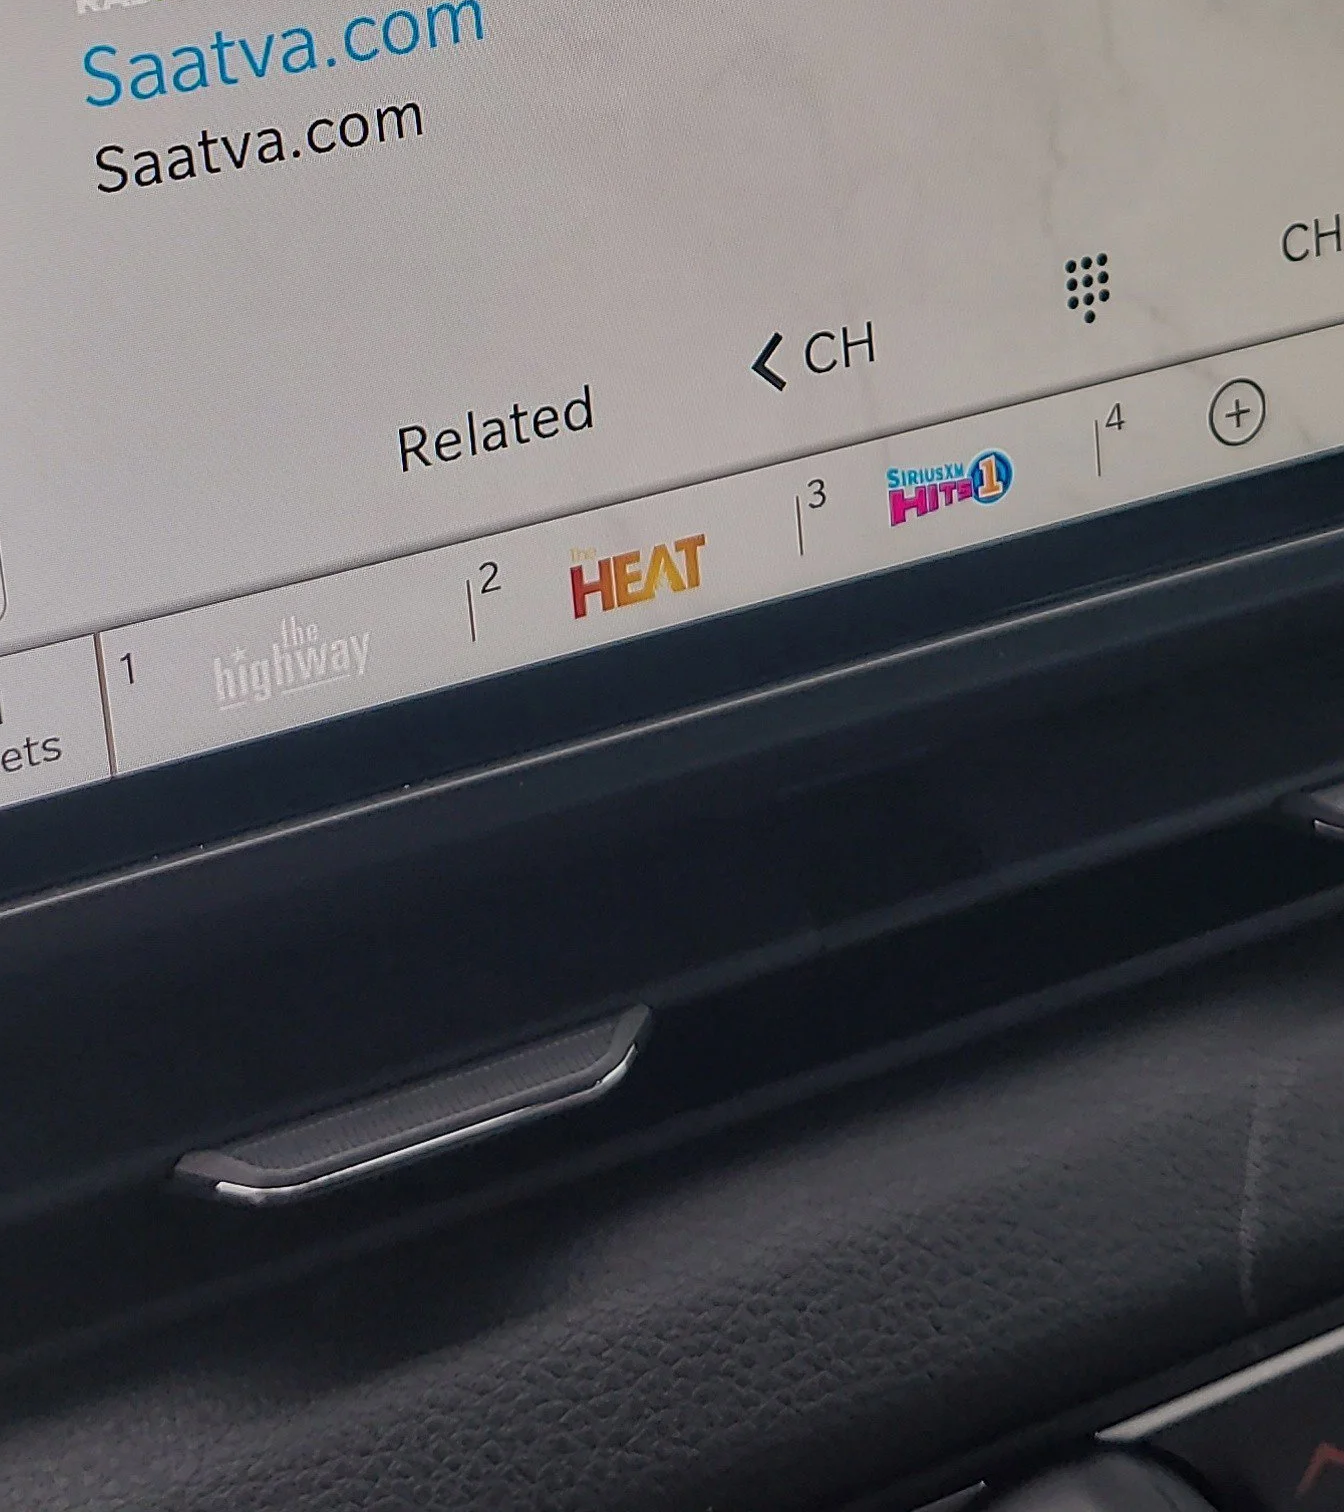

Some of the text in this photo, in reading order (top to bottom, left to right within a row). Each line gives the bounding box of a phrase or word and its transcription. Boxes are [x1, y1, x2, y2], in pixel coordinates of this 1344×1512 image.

[95, 101, 424, 190] Saatva.com
[1281, 215, 1342, 261] CH
[805, 321, 875, 374] CH
[399, 385, 594, 472] Related
[1106, 404, 1125, 432] 4
[808, 480, 826, 509] 3
[889, 478, 973, 526] HITS
[480, 562, 501, 594] 2
[570, 534, 705, 619] HEAT
[281, 616, 319, 648] the
[121, 653, 136, 685] 1
[214, 633, 370, 701] highway
